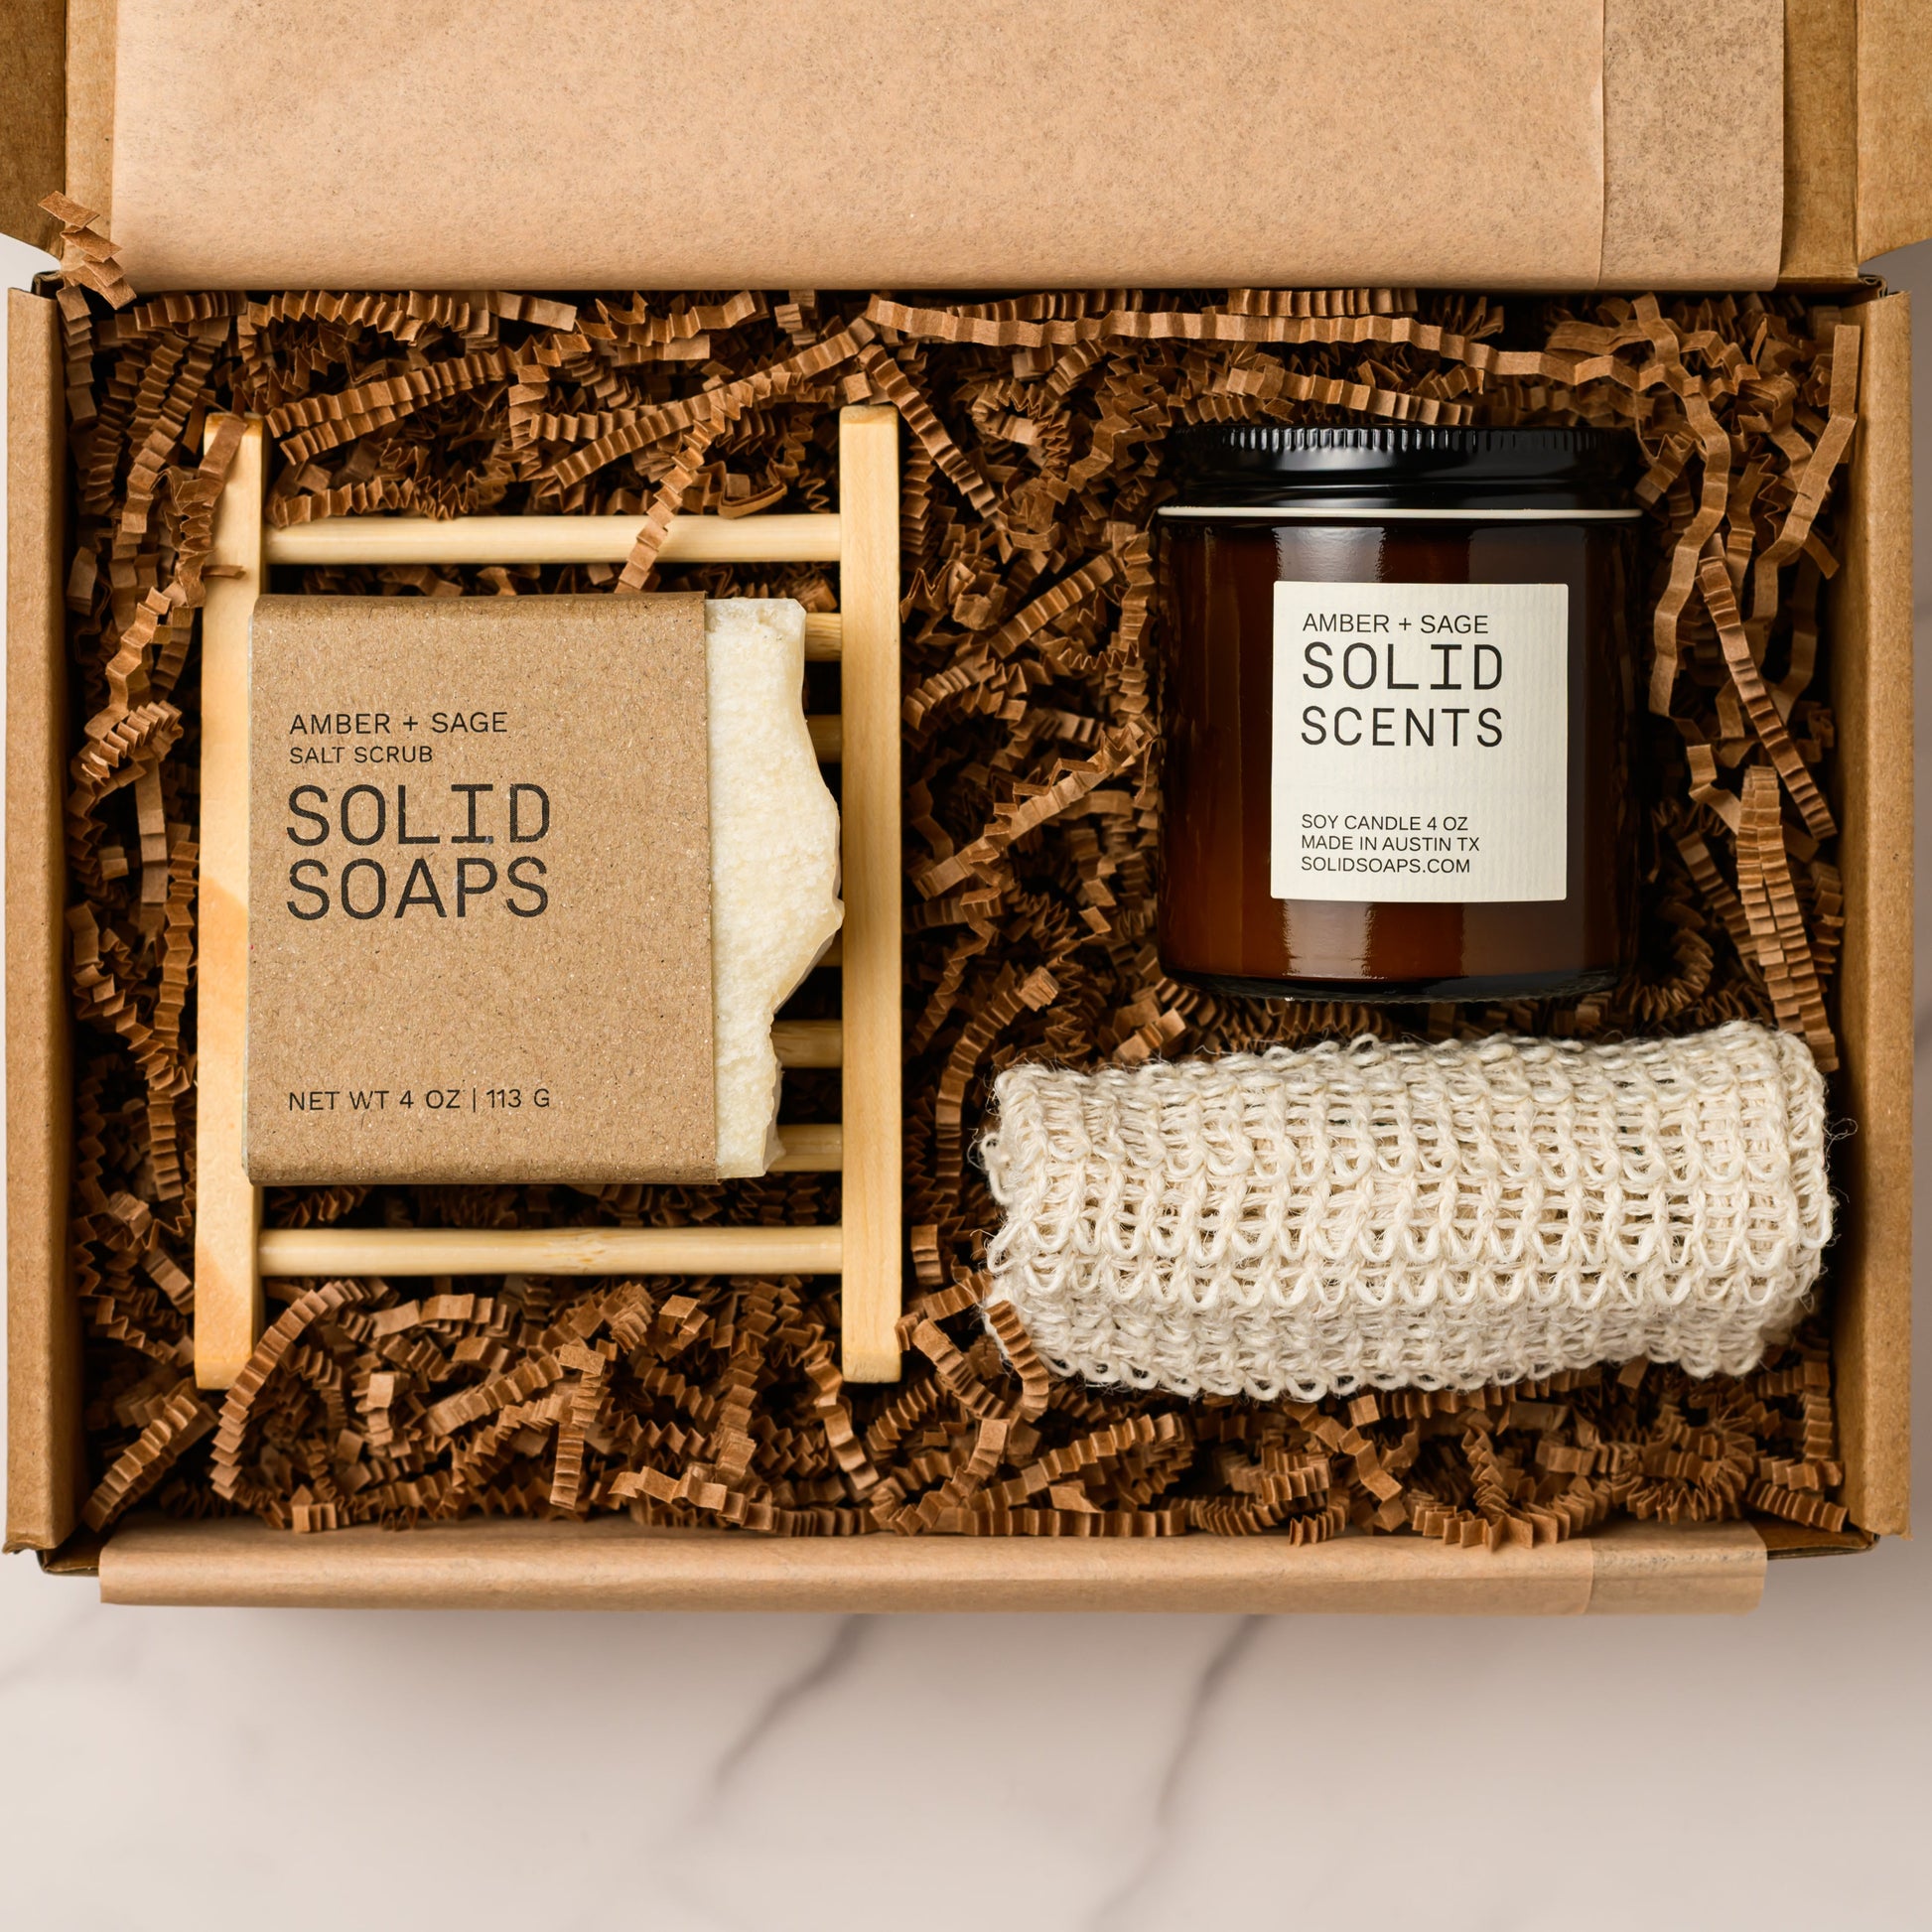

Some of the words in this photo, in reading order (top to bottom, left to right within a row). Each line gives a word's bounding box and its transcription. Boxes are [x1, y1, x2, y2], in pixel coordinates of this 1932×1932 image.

[1302, 613, 1390, 633] AMBER
[1420, 615, 1489, 634] SAGE
[1303, 641, 1503, 691] SOLID
[289, 713, 391, 735] AMBER
[431, 711, 508, 734] SAGE
[1301, 705, 1503, 748] SCENTS
[289, 747, 345, 764] SALT
[353, 746, 433, 763] SCRUB
[286, 782, 550, 847] SOLID
[1302, 813, 1339, 829] SOY
[1344, 815, 1422, 831] CANDLE
[1427, 816, 1438, 831] 4
[1443, 816, 1468, 831] OZ
[1302, 834, 1353, 851] MADE
[1359, 836, 1377, 851] IN
[1381, 836, 1451, 852] AUSTIN
[1456, 836, 1480, 852] TX
[1301, 856, 1470, 874] SOLIDSOAPS.COM
[286, 856, 549, 921] SOAPS
[289, 1091, 341, 1111] NET
[348, 1090, 390, 1110] WT
[399, 1089, 414, 1109] 4
[425, 1089, 461, 1110] OZ
[485, 1088, 522, 1109] 113
[533, 1088, 550, 1108] G
